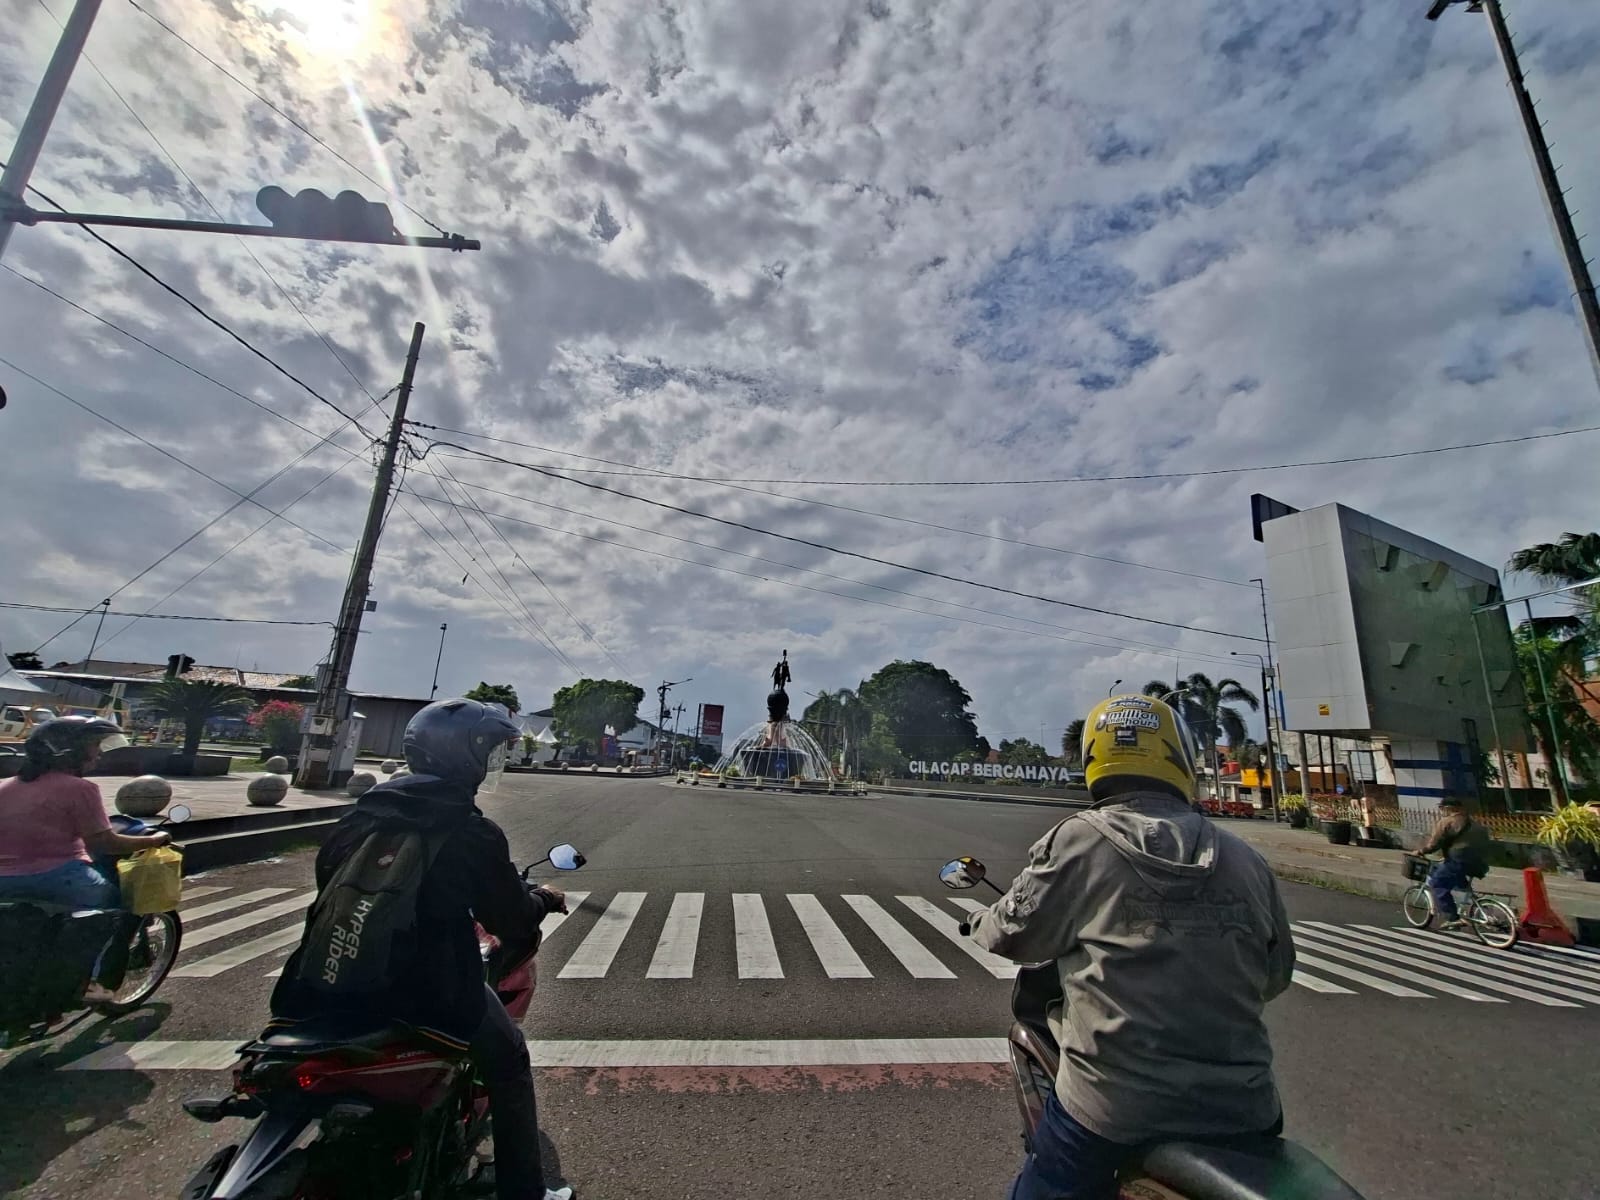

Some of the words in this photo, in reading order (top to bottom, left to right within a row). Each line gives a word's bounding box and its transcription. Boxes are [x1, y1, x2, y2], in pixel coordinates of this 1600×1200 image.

[1108, 709, 1159, 721] million
[1124, 717, 1159, 728] hours
[909, 760, 970, 776] CILACAP
[973, 763, 1070, 782] BERCAHAYA
[343, 899, 373, 960] HYPER
[322, 924, 347, 985] RIDER
